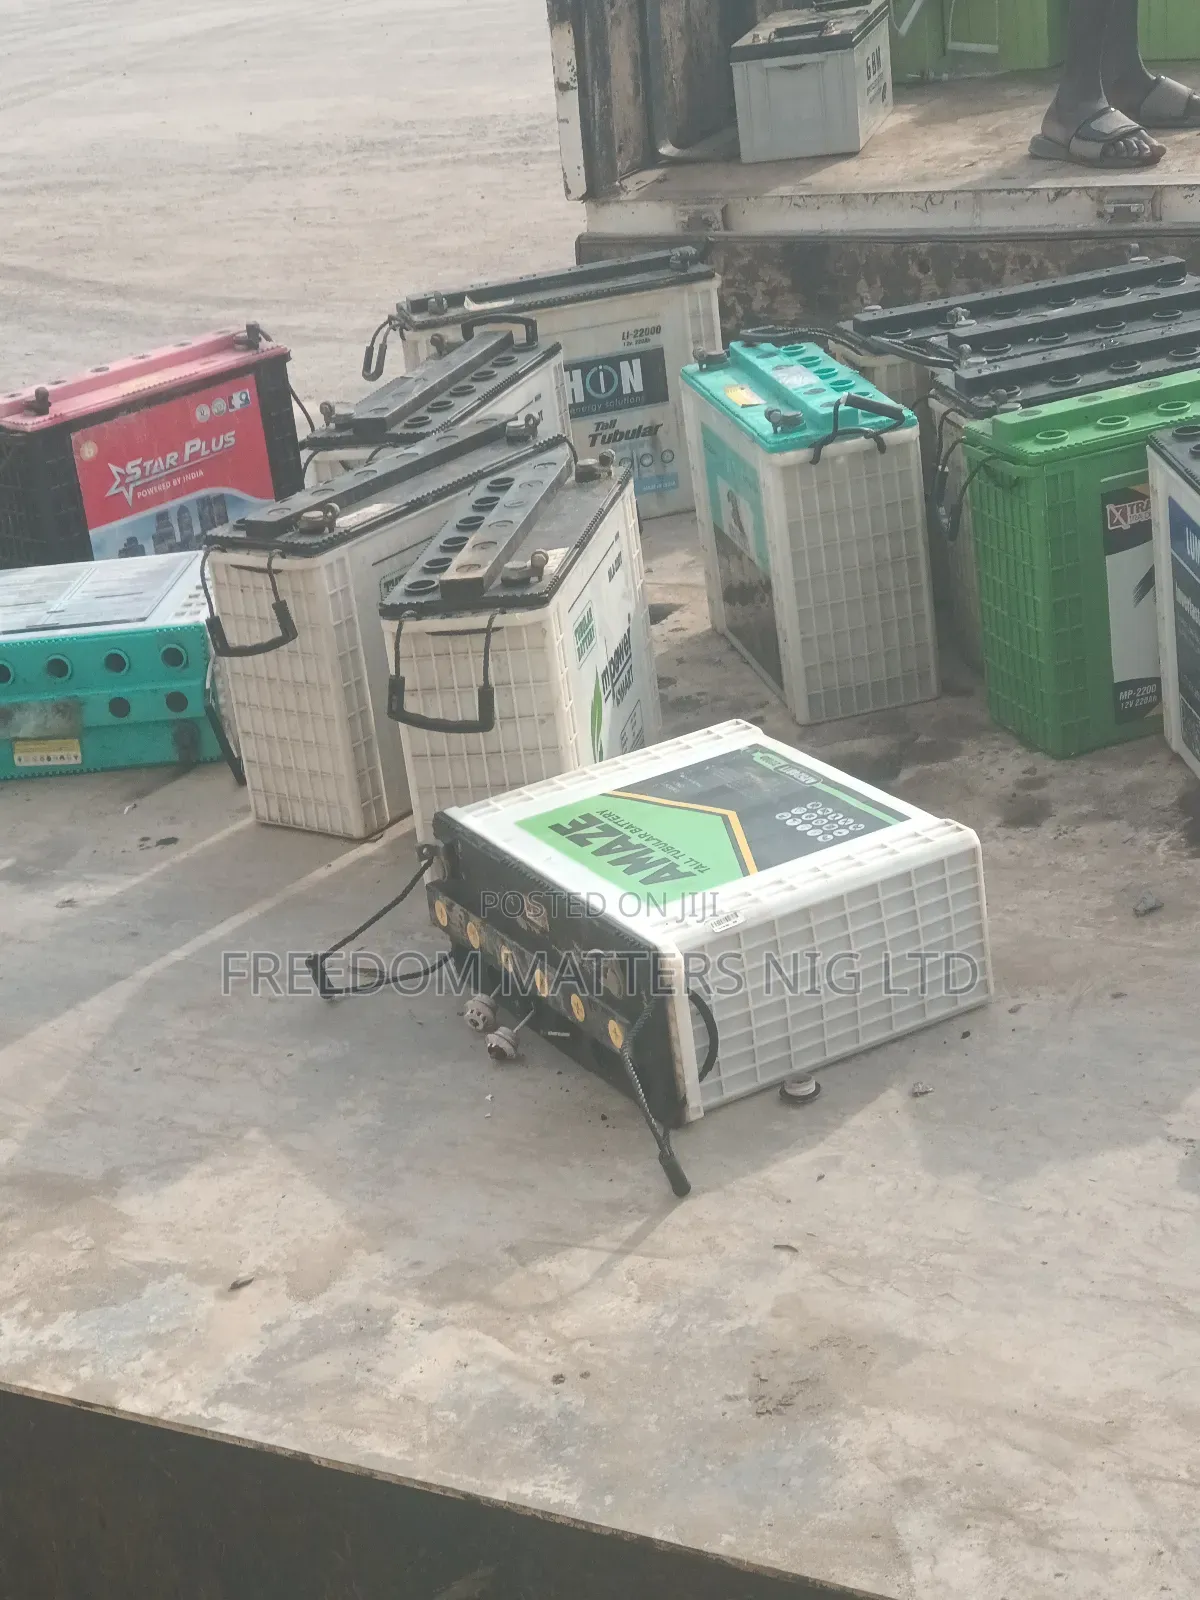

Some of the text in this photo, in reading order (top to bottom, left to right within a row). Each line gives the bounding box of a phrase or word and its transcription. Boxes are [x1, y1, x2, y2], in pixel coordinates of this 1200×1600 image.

[588, 422, 664, 448] Tubular
[593, 418, 618, 432] Tall
[136, 469, 204, 499] POWERED BY INDIA
[548, 812, 697, 886] AMAZE
[596, 809, 711, 874] TALL TUBULAR BATTERY
